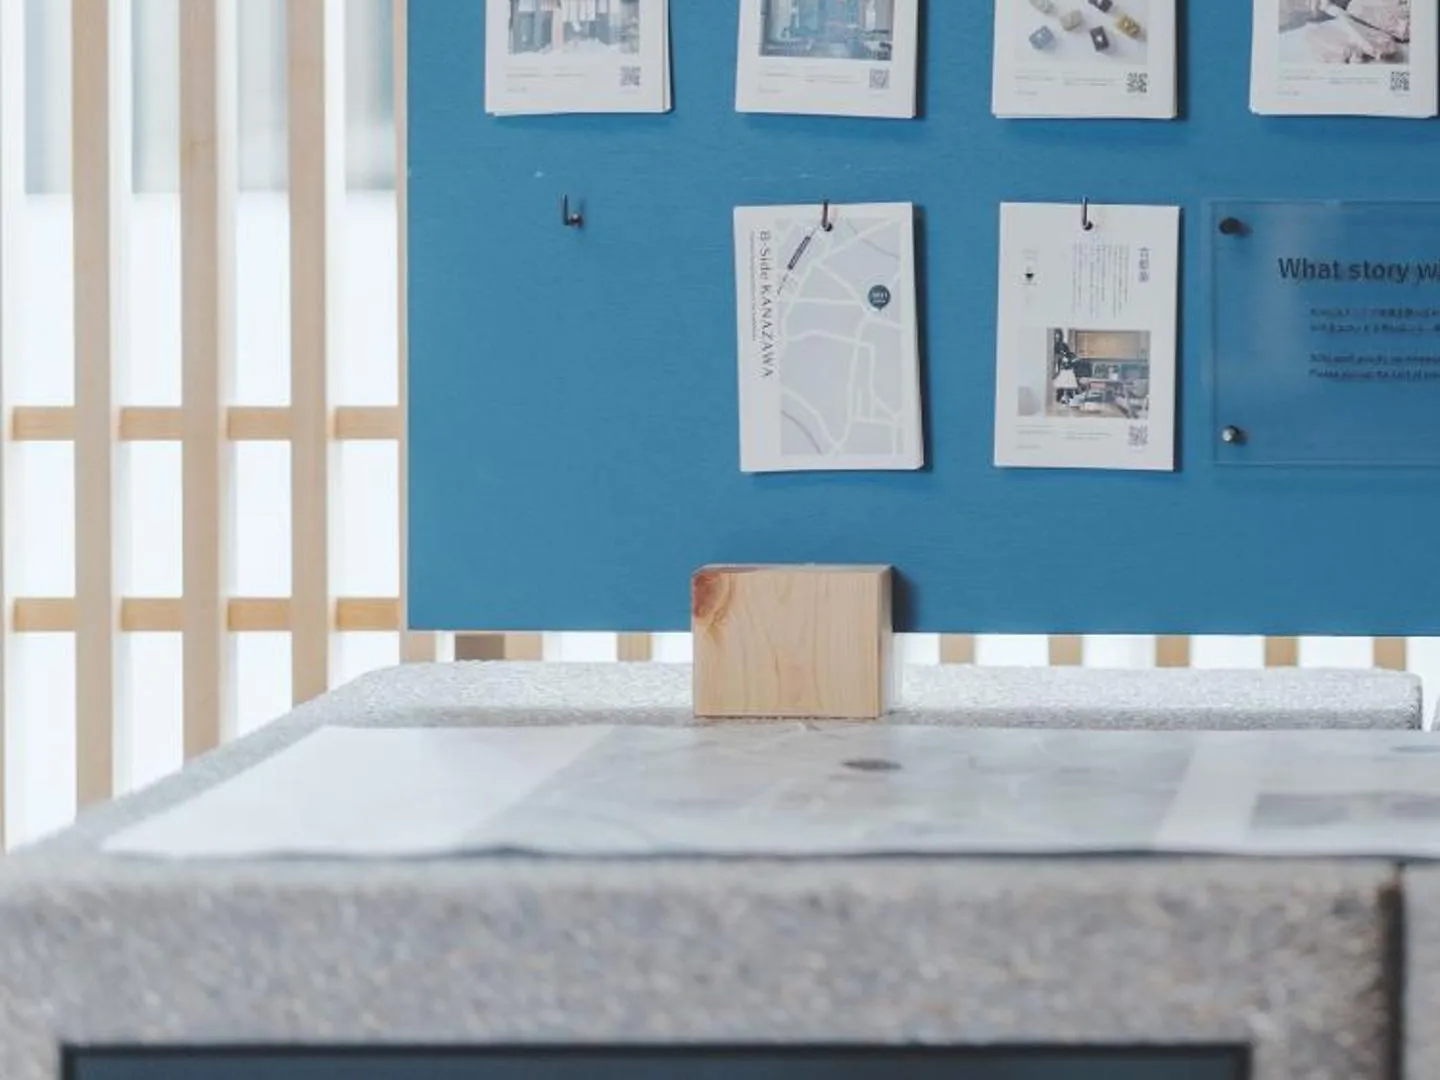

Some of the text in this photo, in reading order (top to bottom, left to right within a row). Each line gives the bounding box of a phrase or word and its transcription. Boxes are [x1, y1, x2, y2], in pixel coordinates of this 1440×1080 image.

[760, 230, 774, 378] B-Side KANAZAWA
[1277, 257, 1342, 281] What
[1348, 259, 1409, 284] story
